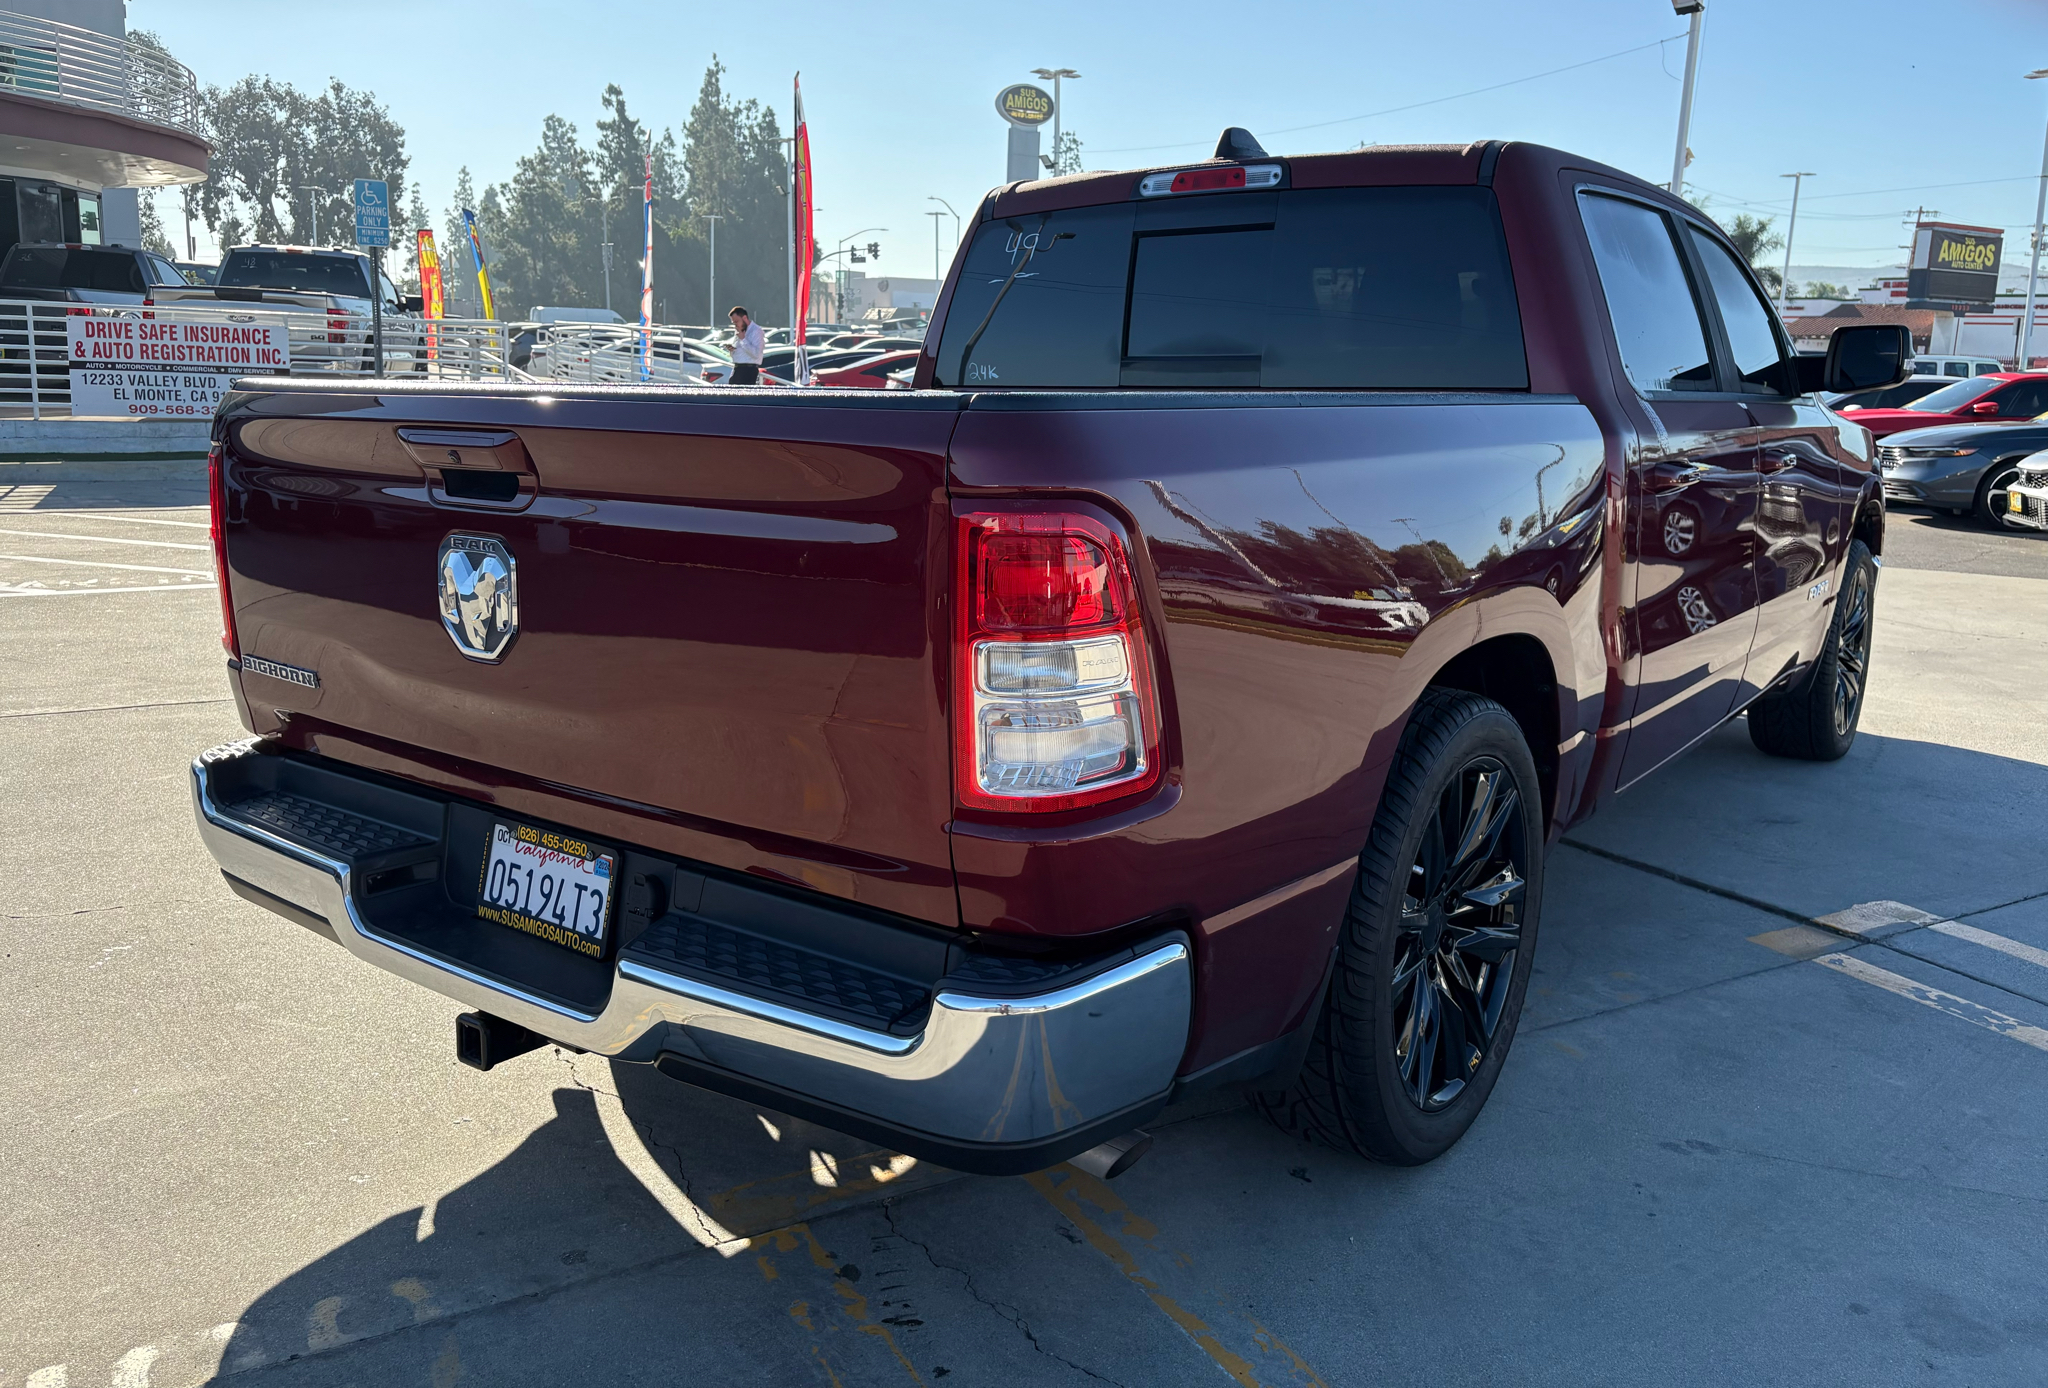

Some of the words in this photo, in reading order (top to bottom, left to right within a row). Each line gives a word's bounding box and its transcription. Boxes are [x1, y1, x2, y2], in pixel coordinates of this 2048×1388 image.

[1006, 94, 1048, 112] AMIGOS
[1020, 88, 1036, 98] SUS
[357, 206, 386, 217] PARKING
[363, 216, 381, 226] ONLY
[1005, 232, 1039, 265] 49
[1965, 237, 1975, 245] SUS
[1938, 240, 1995, 267] AMIGOS
[1951, 261, 1964, 269] AUTO
[1965, 262, 1983, 270] CENTER
[85, 321, 133, 339] DRIVE
[139, 323, 178, 341] SAFE
[184, 325, 271, 345] INSURANCE
[75, 341, 86, 358] &
[92, 342, 134, 359] AUTO
[140, 343, 250, 363] REGISTRATION
[256, 348, 286, 365] INC.
[81, 373, 123, 385] 12233
[128, 375, 178, 387] VALLEY
[184, 376, 220, 389] BLVD.
[114, 388, 130, 400] EL
[135, 389, 186, 403] MONTE,
[191, 390, 208, 402] CA
[451, 537, 496, 552] RAM
[242, 655, 316, 688] BIGHORN
[517, 825, 540, 845] (626)
[542, 833, 587, 857] 455-0250
[515, 840, 593, 874] California
[489, 859, 604, 937] 05194T3
[478, 905, 600, 957] www.SUSAMIGOSAUTO.com
